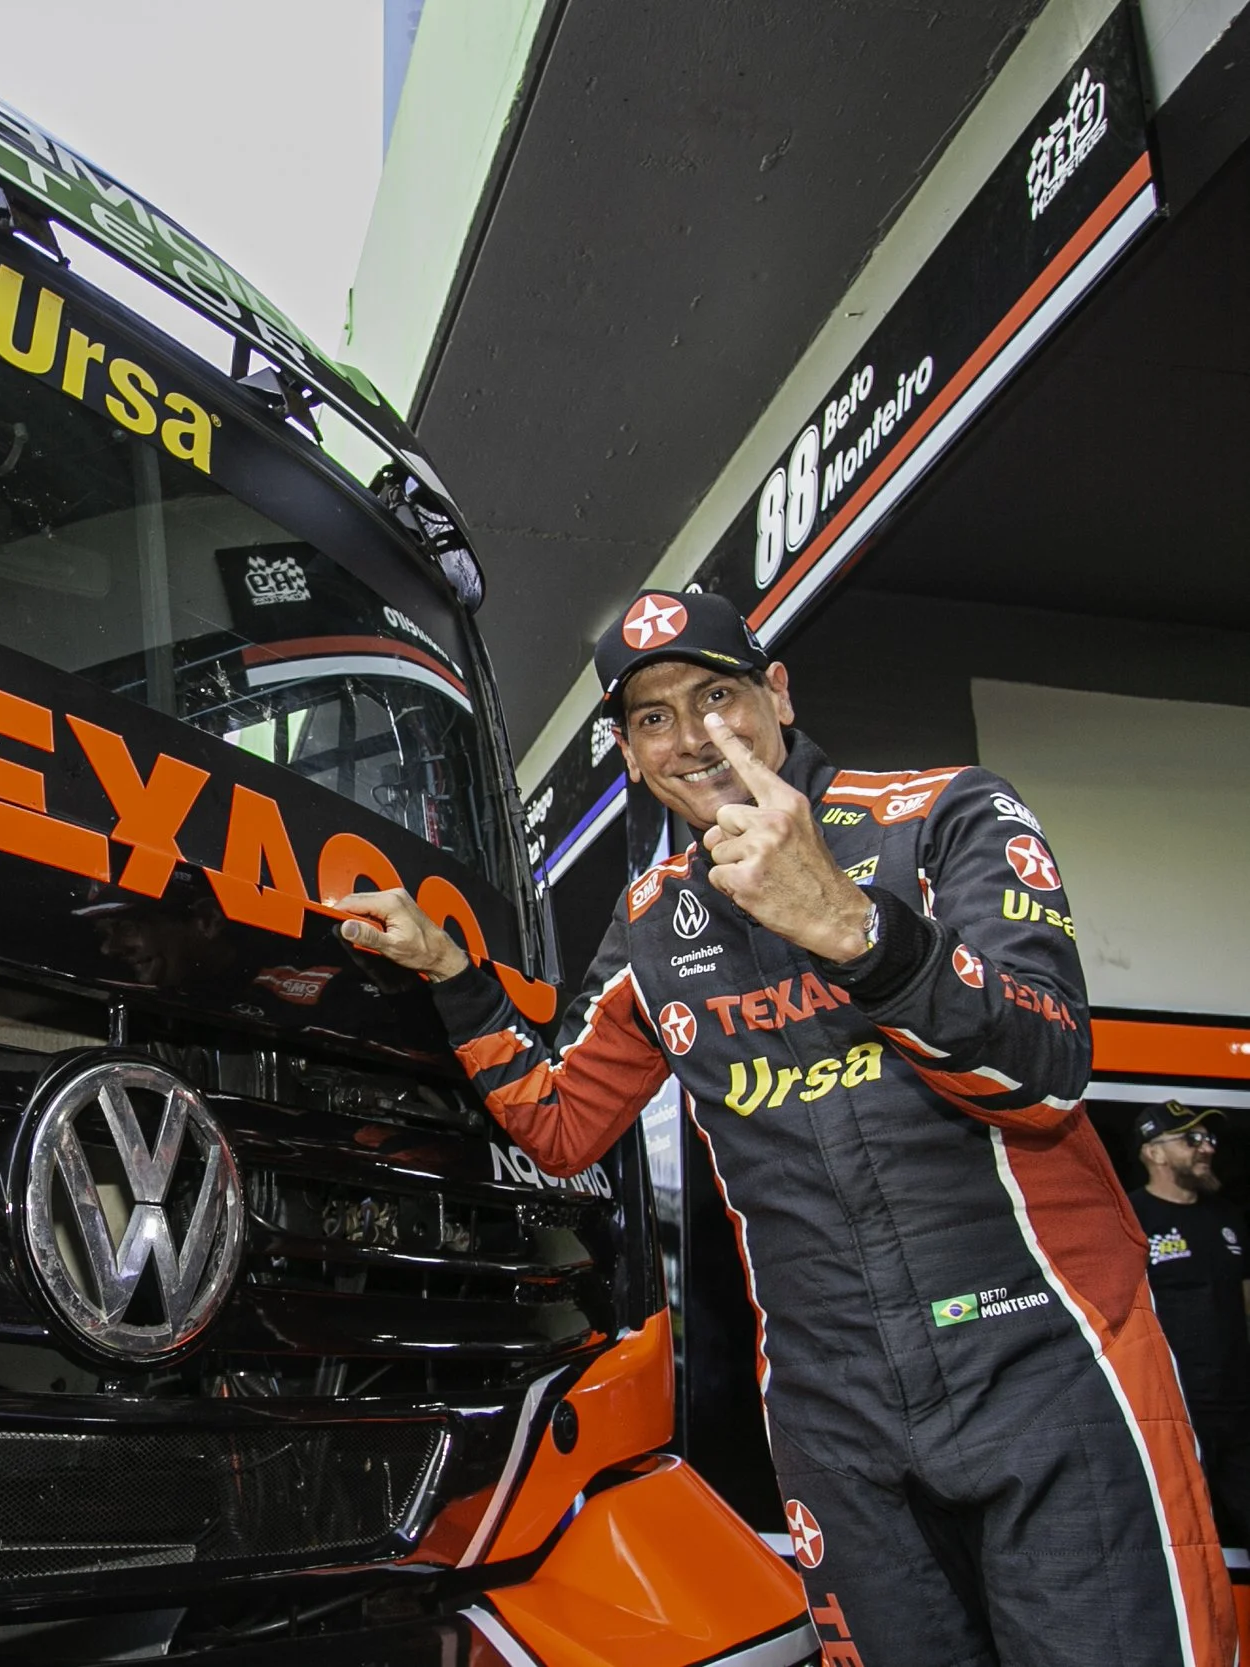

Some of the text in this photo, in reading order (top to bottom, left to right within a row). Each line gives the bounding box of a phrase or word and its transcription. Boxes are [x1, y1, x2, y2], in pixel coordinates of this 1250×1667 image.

[822, 365, 874, 450] Beto
[821, 356, 934, 512] Monteiro
[755, 415, 820, 587] 88
[671, 944, 724, 967] Caminhões
[679, 962, 717, 978] Ônibus
[724, 1042, 885, 1117] Ursa
[980, 1287, 1008, 1305] BETO
[980, 1292, 1049, 1319] MONTEIRO
